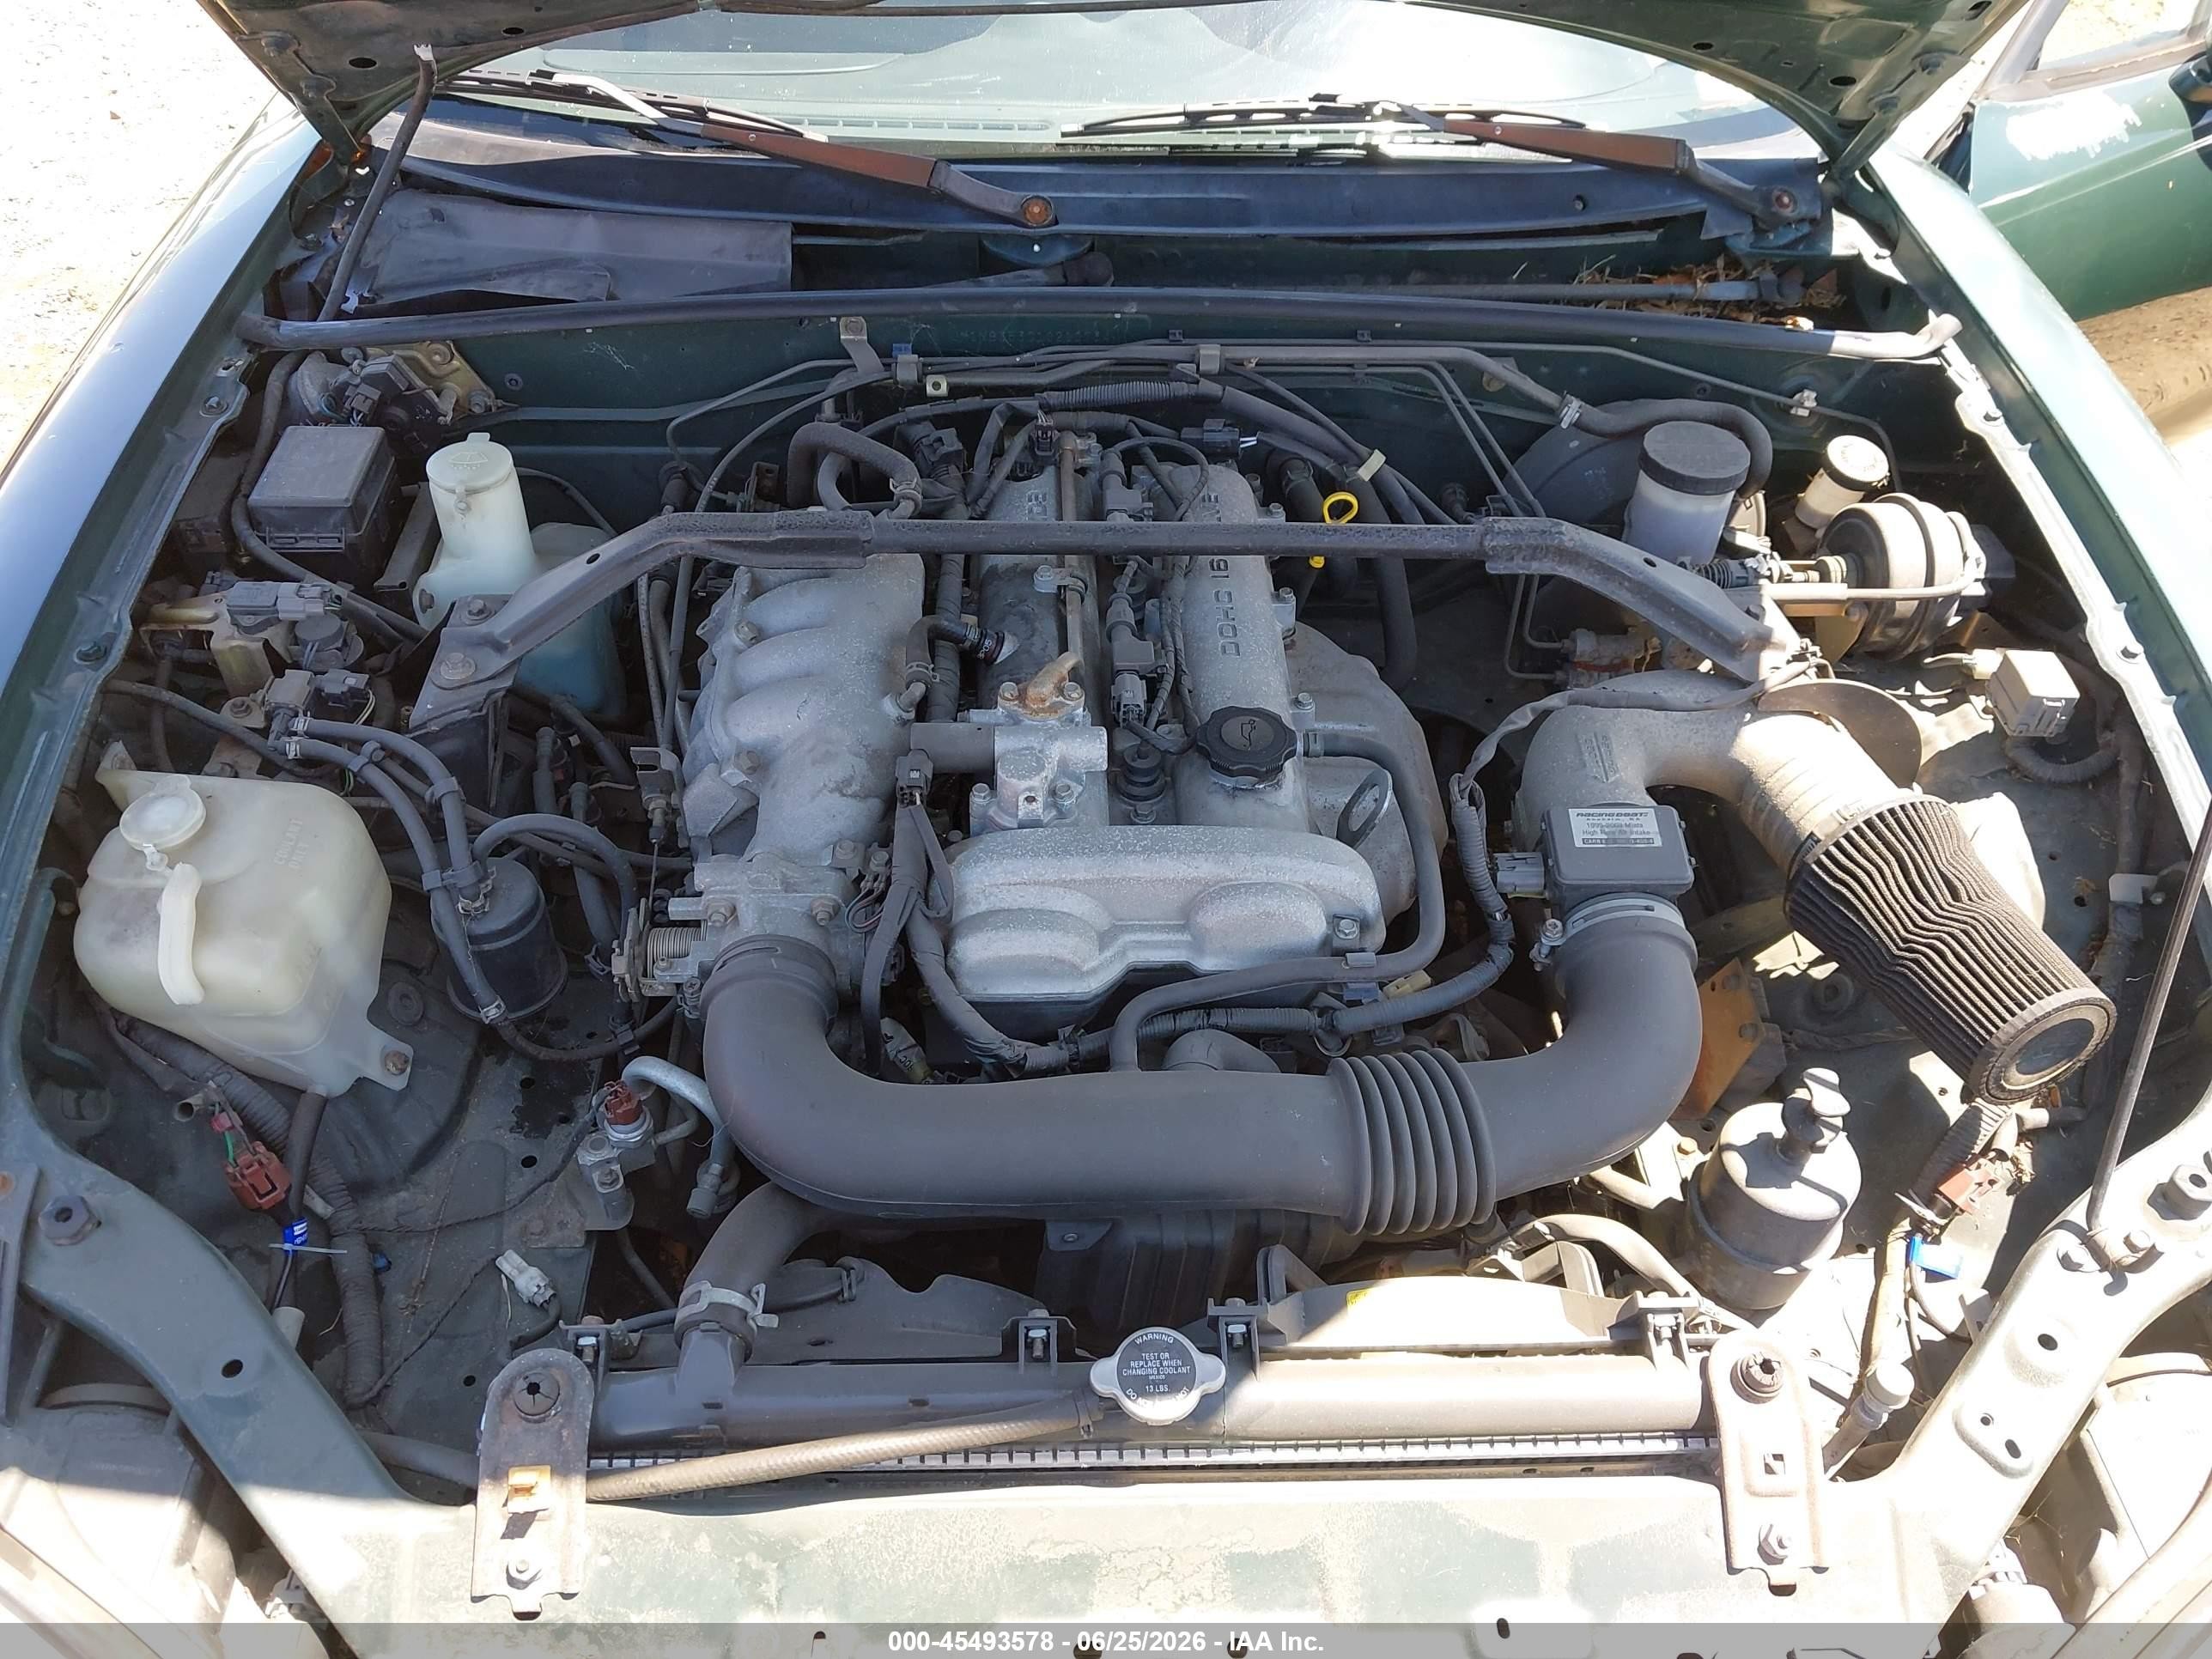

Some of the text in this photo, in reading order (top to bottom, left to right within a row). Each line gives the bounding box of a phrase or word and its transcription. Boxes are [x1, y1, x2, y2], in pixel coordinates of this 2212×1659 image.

[1213, 589, 1241, 657] DOHC
[1134, 1333, 1174, 1345] WARNING
[1126, 1388, 1138, 1400] DO
